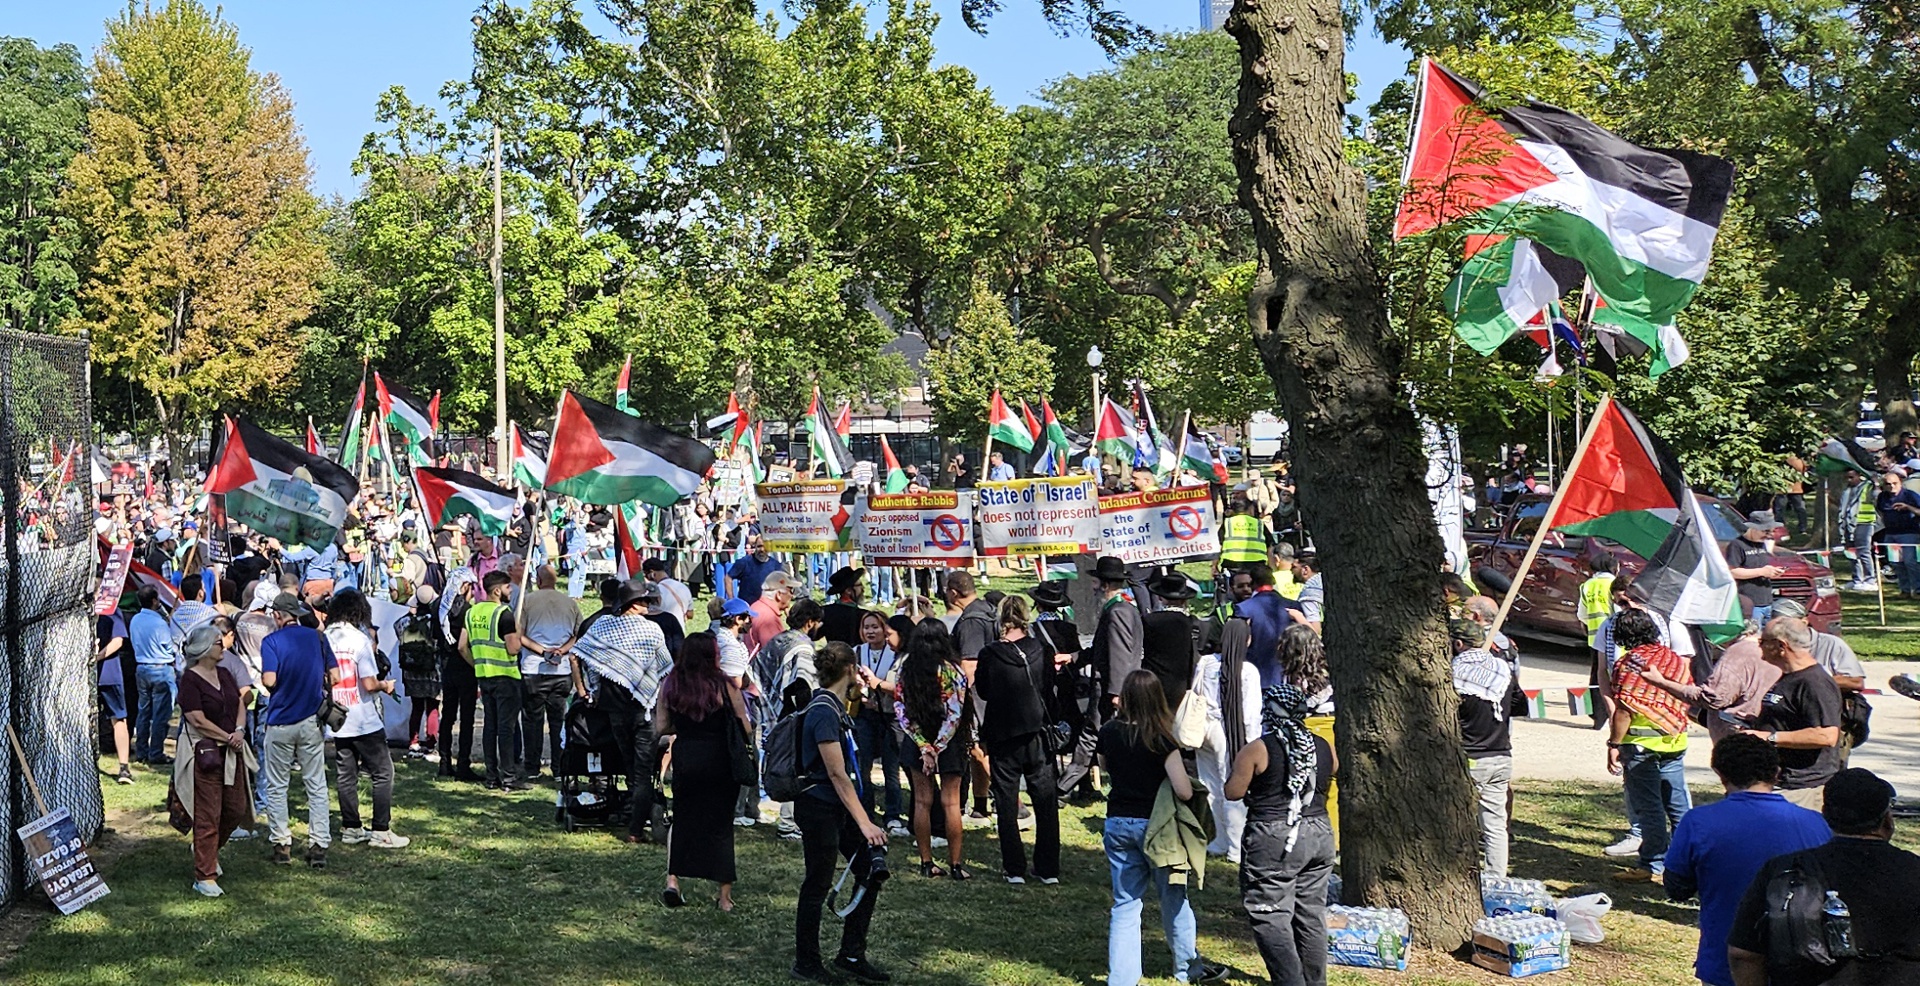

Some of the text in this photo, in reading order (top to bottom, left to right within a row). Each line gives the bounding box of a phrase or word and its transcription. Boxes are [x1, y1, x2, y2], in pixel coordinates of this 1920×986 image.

[766, 483, 837, 494] Torah Demands
[980, 481, 1093, 506] State of "Israel"
[871, 495, 955, 507] Authentic Rabbis
[1098, 487, 1207, 510] udaism Condemns
[762, 500, 833, 514] ALL PALESTINE
[860, 512, 920, 525] always opposed
[983, 505, 1097, 524] does not represent
[1114, 514, 1134, 524] the
[764, 525, 829, 536] Palestinian Sovereignty
[868, 526, 912, 536] Zionism
[1008, 524, 1075, 538] world Jewry
[1102, 522, 1150, 538] State of
[863, 543, 922, 553] State of Israel
[1133, 549, 1149, 560] its
[1153, 541, 1213, 557] Atrocities
[889, 559, 947, 567] www.NKUSA.org
[39, 820, 47, 828] TO
[35, 837, 82, 868] OF GAZA
[41, 851, 89, 880] THE BUTCHER
[47, 862, 94, 893] LEGACY:
